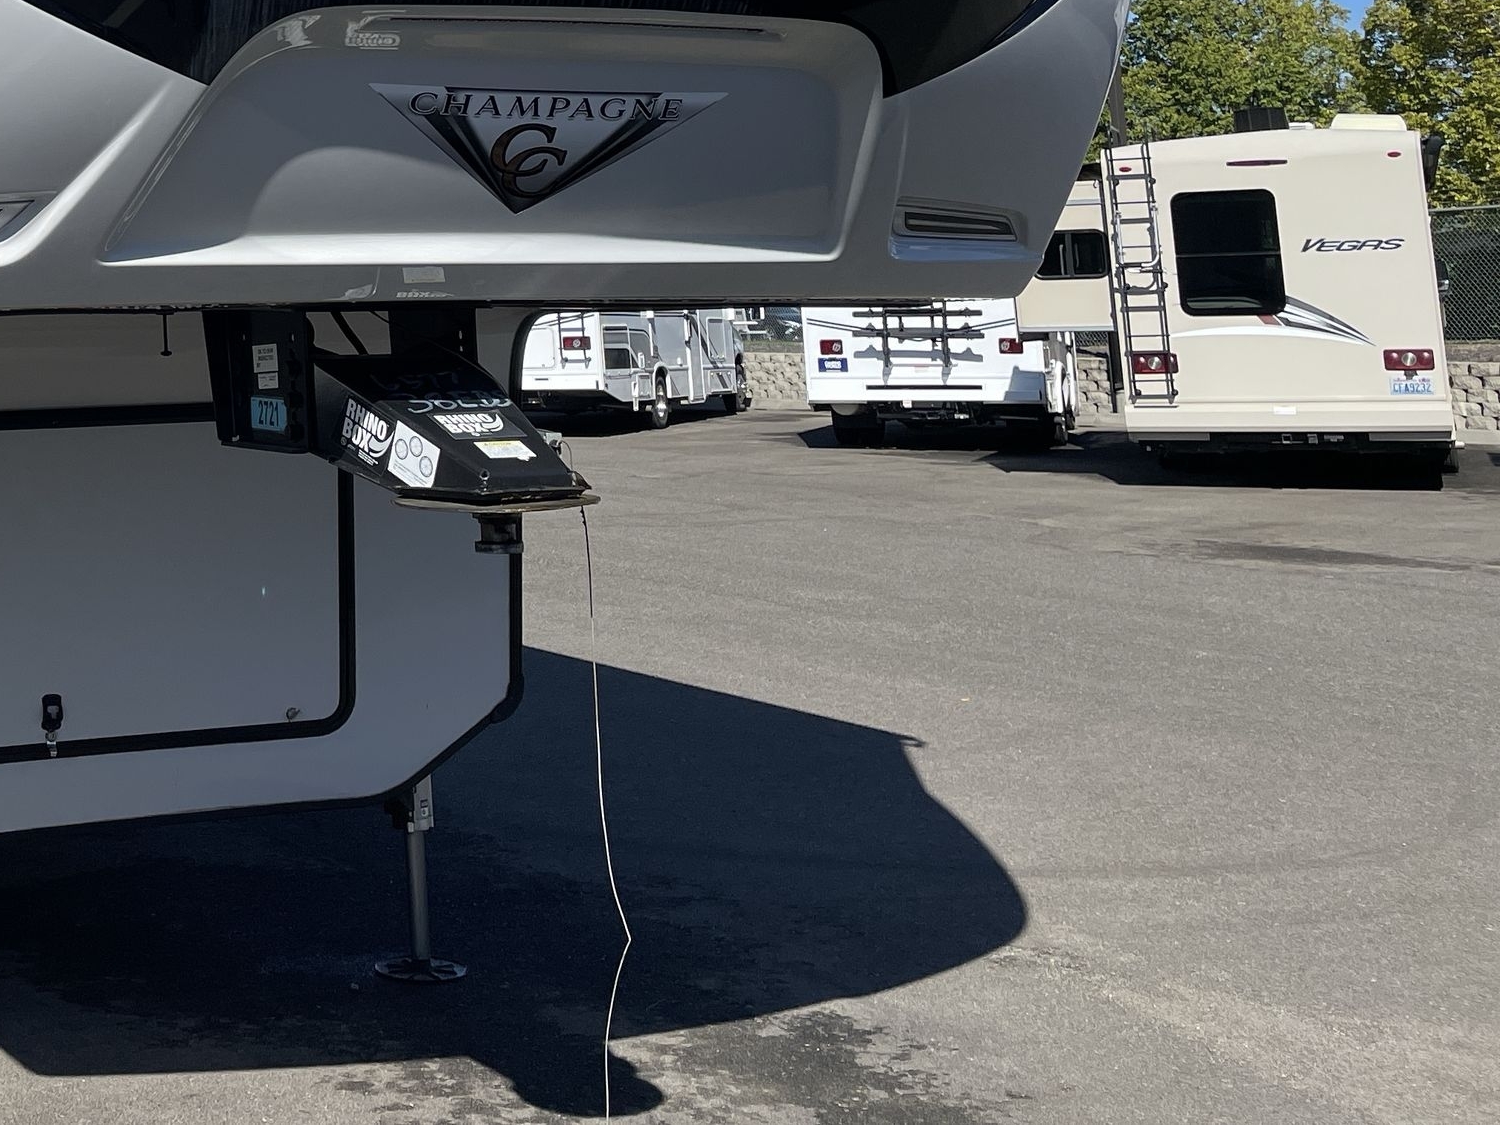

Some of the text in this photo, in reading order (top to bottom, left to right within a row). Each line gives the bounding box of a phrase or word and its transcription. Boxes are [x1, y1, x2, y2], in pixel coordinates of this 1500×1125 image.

[409, 92, 683, 121] CHAMPAGNE
[1300, 238, 1405, 253] VEGAS
[258, 400, 279, 428] 2721
[346, 398, 387, 441] RHINO
[433, 413, 494, 425] RHINO
[443, 422, 491, 434] BOX
[342, 416, 372, 454] BOX
